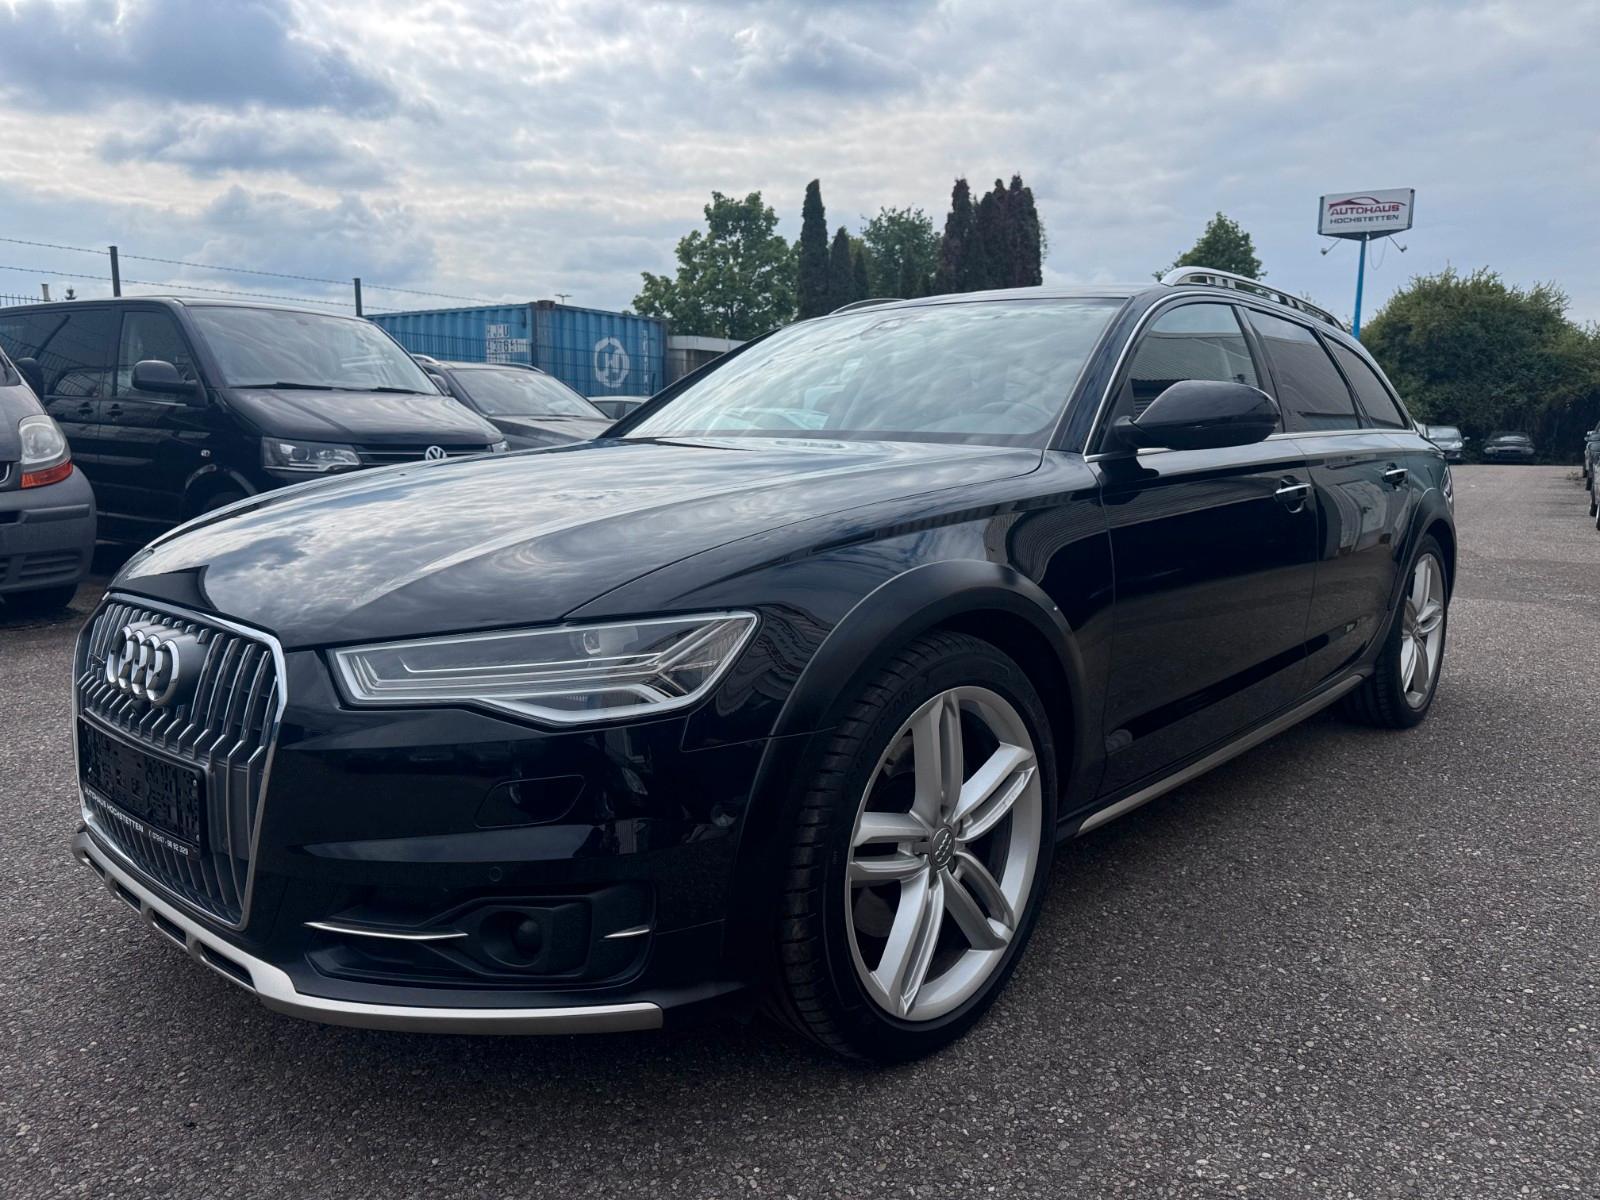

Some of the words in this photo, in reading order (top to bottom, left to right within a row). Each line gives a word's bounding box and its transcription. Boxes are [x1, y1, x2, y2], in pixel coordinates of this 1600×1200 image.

[1330, 204, 1399, 216] AUTOHAUS
[1330, 214, 1399, 224] HOCHSTETTEN
[107, 803, 144, 832] HOCHSTETTEN
